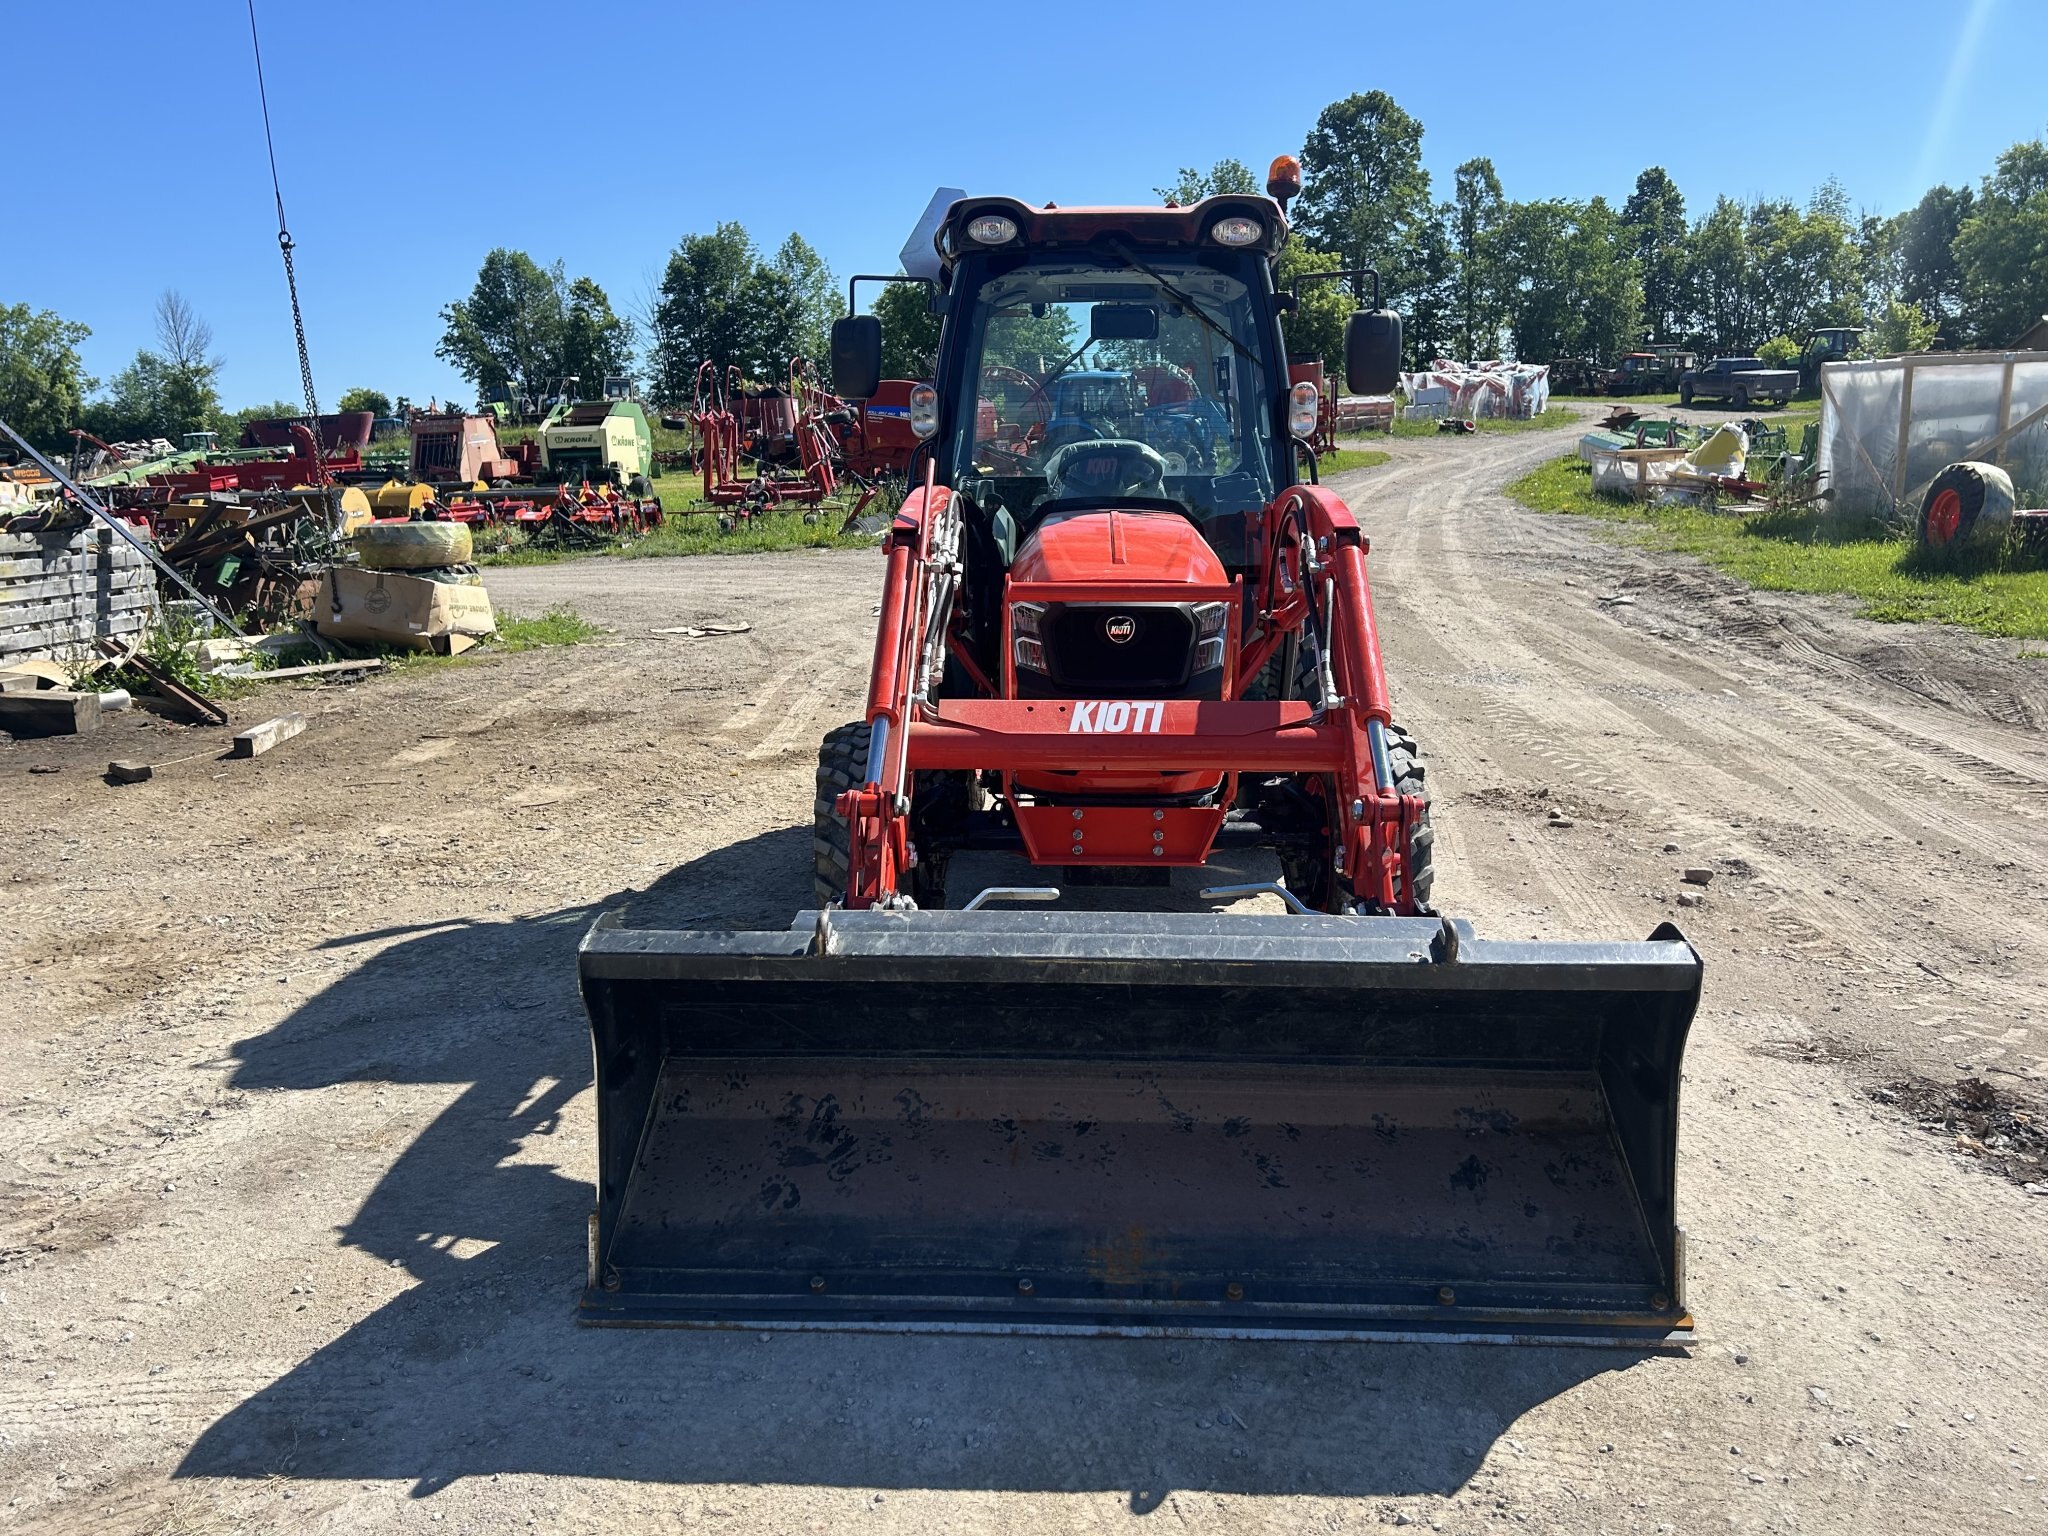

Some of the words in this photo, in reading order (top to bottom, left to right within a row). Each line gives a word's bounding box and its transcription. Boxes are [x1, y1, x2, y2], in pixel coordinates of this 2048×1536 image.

[564, 435, 592, 443] KRONE
[618, 437, 635, 447] KRONE
[1110, 625, 1131, 635] KIOTI
[1069, 701, 1165, 733] KIOTI
